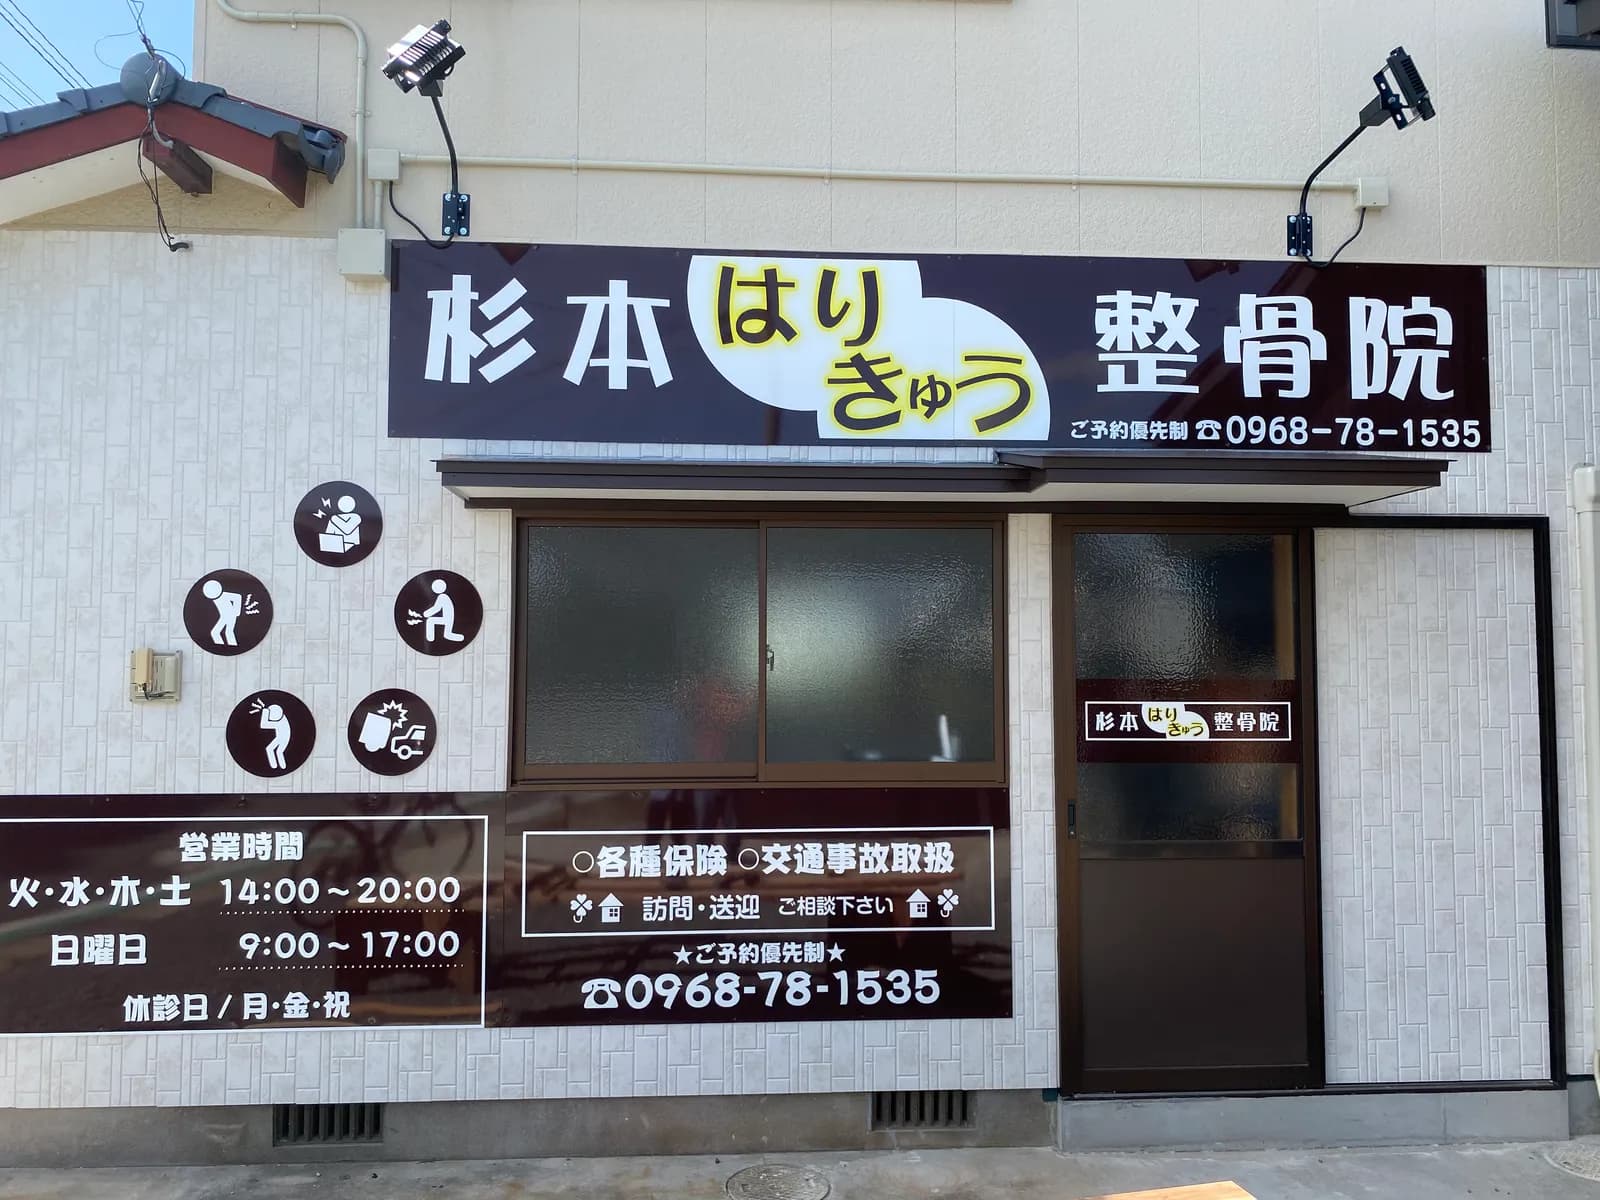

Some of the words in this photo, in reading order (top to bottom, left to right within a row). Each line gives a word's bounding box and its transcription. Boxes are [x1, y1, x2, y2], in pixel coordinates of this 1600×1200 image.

[716, 263, 882, 349] はり
[424, 274, 674, 391] 杉本
[1094, 289, 1455, 401] 整骨院
[825, 351, 1034, 435] きゅう
[1070, 419, 1188, 442] ご予約優先制
[1226, 415, 1481, 448] 0968-78-1535
[1095, 711, 1139, 732] 杉本
[1147, 706, 1178, 723] はり
[1167, 721, 1205, 737] きゅう
[1213, 711, 1280, 732] 整骨院
[178, 831, 304, 862] 営業時間
[642, 894, 761, 922] 訪問・送迎
[777, 895, 895, 917] ご相談下さい
[50, 934, 148, 966] 日曜日
[625, 968, 941, 1011] 0968-78-1535
